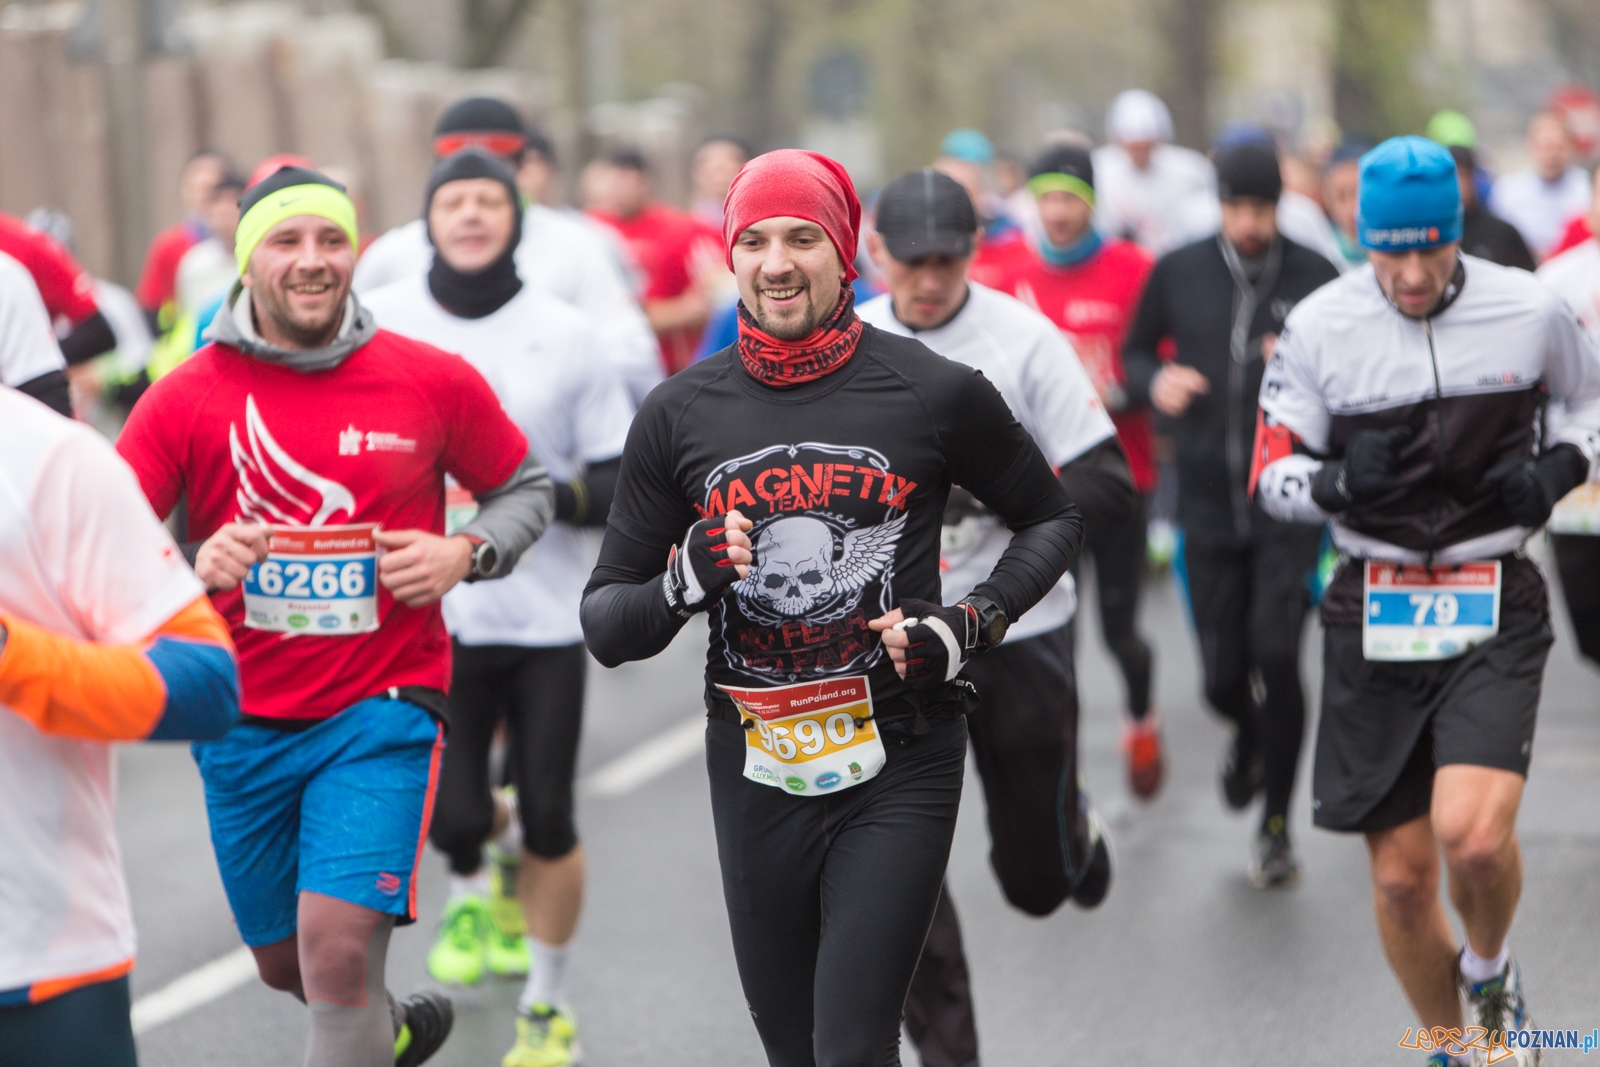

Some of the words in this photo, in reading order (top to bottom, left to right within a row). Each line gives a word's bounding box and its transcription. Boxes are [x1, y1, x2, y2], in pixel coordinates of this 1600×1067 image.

[769, 492, 829, 514] TEAM
[258, 561, 366, 598] 6266
[1408, 593, 1459, 626] 79
[737, 627, 775, 651] NO
[782, 608, 869, 648] FEAR
[791, 632, 871, 674] PAIN
[790, 688, 857, 707] RunPoland.org
[754, 712, 856, 761] 9690
